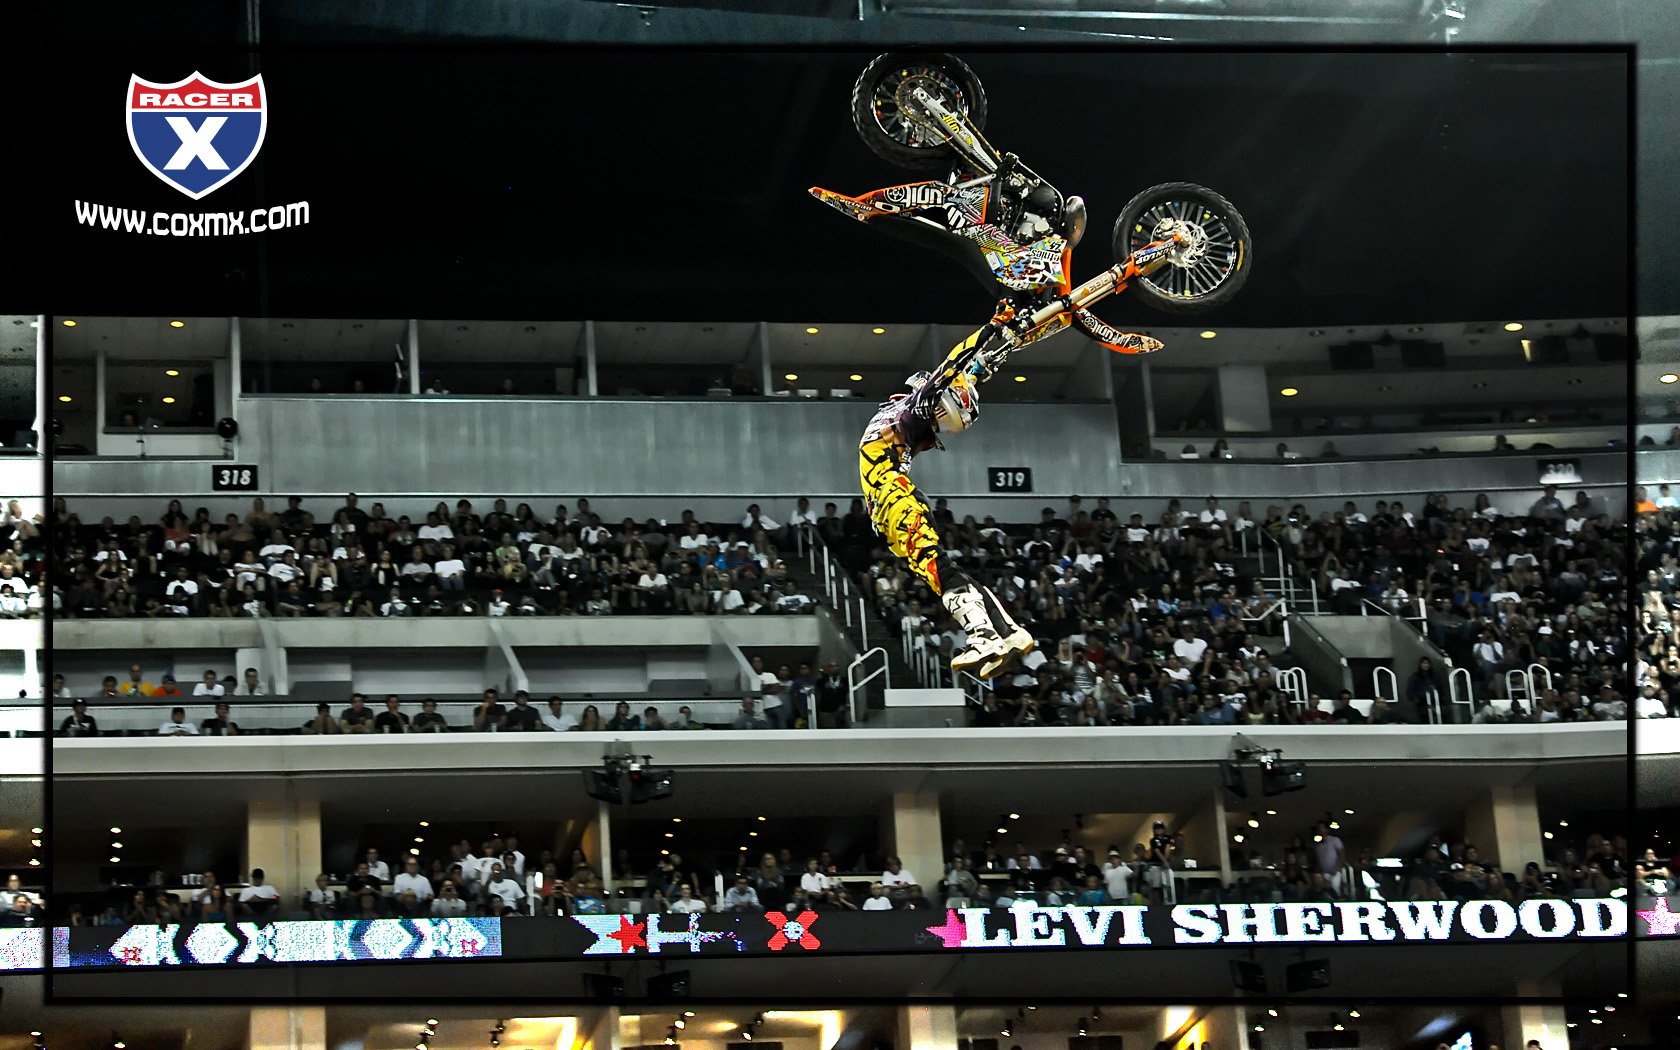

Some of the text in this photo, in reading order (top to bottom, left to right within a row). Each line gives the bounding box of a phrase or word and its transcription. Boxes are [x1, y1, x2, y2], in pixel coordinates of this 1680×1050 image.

[902, 184, 944, 208] unit
[219, 469, 251, 486] 318
[995, 471, 1025, 487] 319
[957, 898, 1627, 947] LEVI SHERWOOD
